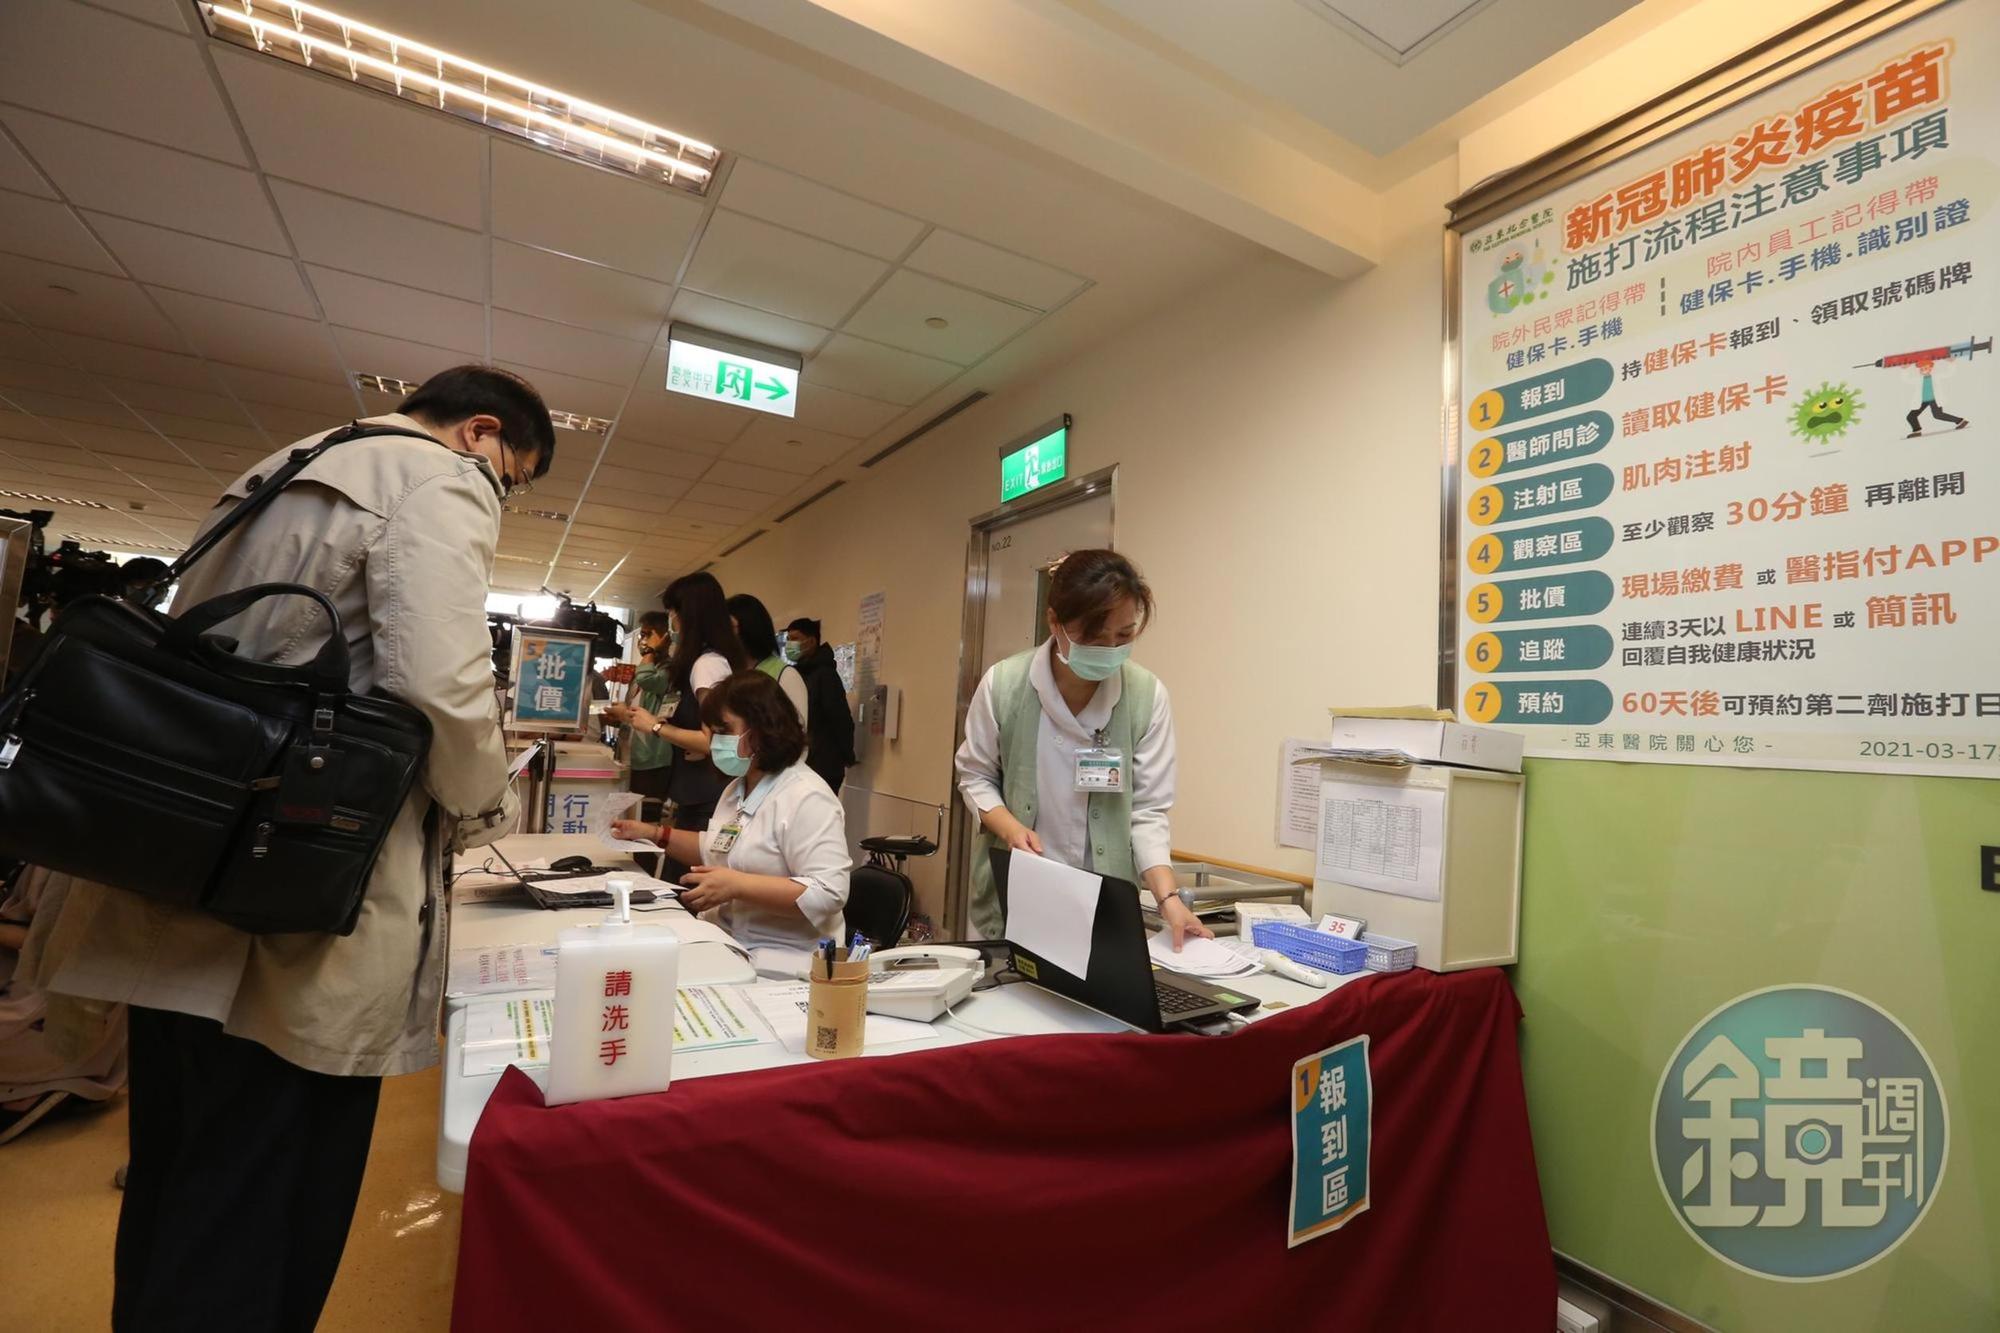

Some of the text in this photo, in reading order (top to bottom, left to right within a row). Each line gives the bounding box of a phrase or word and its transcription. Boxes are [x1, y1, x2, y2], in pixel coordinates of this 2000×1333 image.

[1564, 46, 1946, 251] 新冠肺炎疫苗
[1566, 107, 1949, 292] 施打流程注意事項
[1705, 175, 1939, 279] 院內員工記得帶
[1491, 282, 1646, 352] 院外民眾記得帶
[671, 375, 711, 392] EXIT
[1479, 378, 1565, 423] 1 報到
[1621, 374, 1788, 438] 讀取健保卡
[1478, 421, 1600, 469] 2 醫師問診
[1621, 440, 1752, 492] 肌肉注射
[1478, 477, 1583, 516] 3 注射區
[1621, 470, 1966, 543] 至少觀察 30分鐘 再離開
[1476, 530, 1583, 564] 4 觀察區
[1477, 585, 1566, 614] 5 批價
[1621, 563, 1744, 600] 現場繳費
[1756, 568, 1777, 586] 或
[1621, 592, 1958, 642] 連續3天以 LINE 或 簡訊
[1475, 637, 1566, 663] 6 追蹤
[1621, 638, 1816, 667] 回覆自我健康狀況
[534, 652, 567, 711] 批價
[1474, 690, 1565, 714] 7 預約
[1859, 740, 2000, 761] 2021-03-17
[1328, 920, 1346, 934] 35
[599, 970, 632, 1066] 請洗手
[1300, 1069, 1310, 1096] 1
[1319, 1065, 1350, 1216] 報到區
